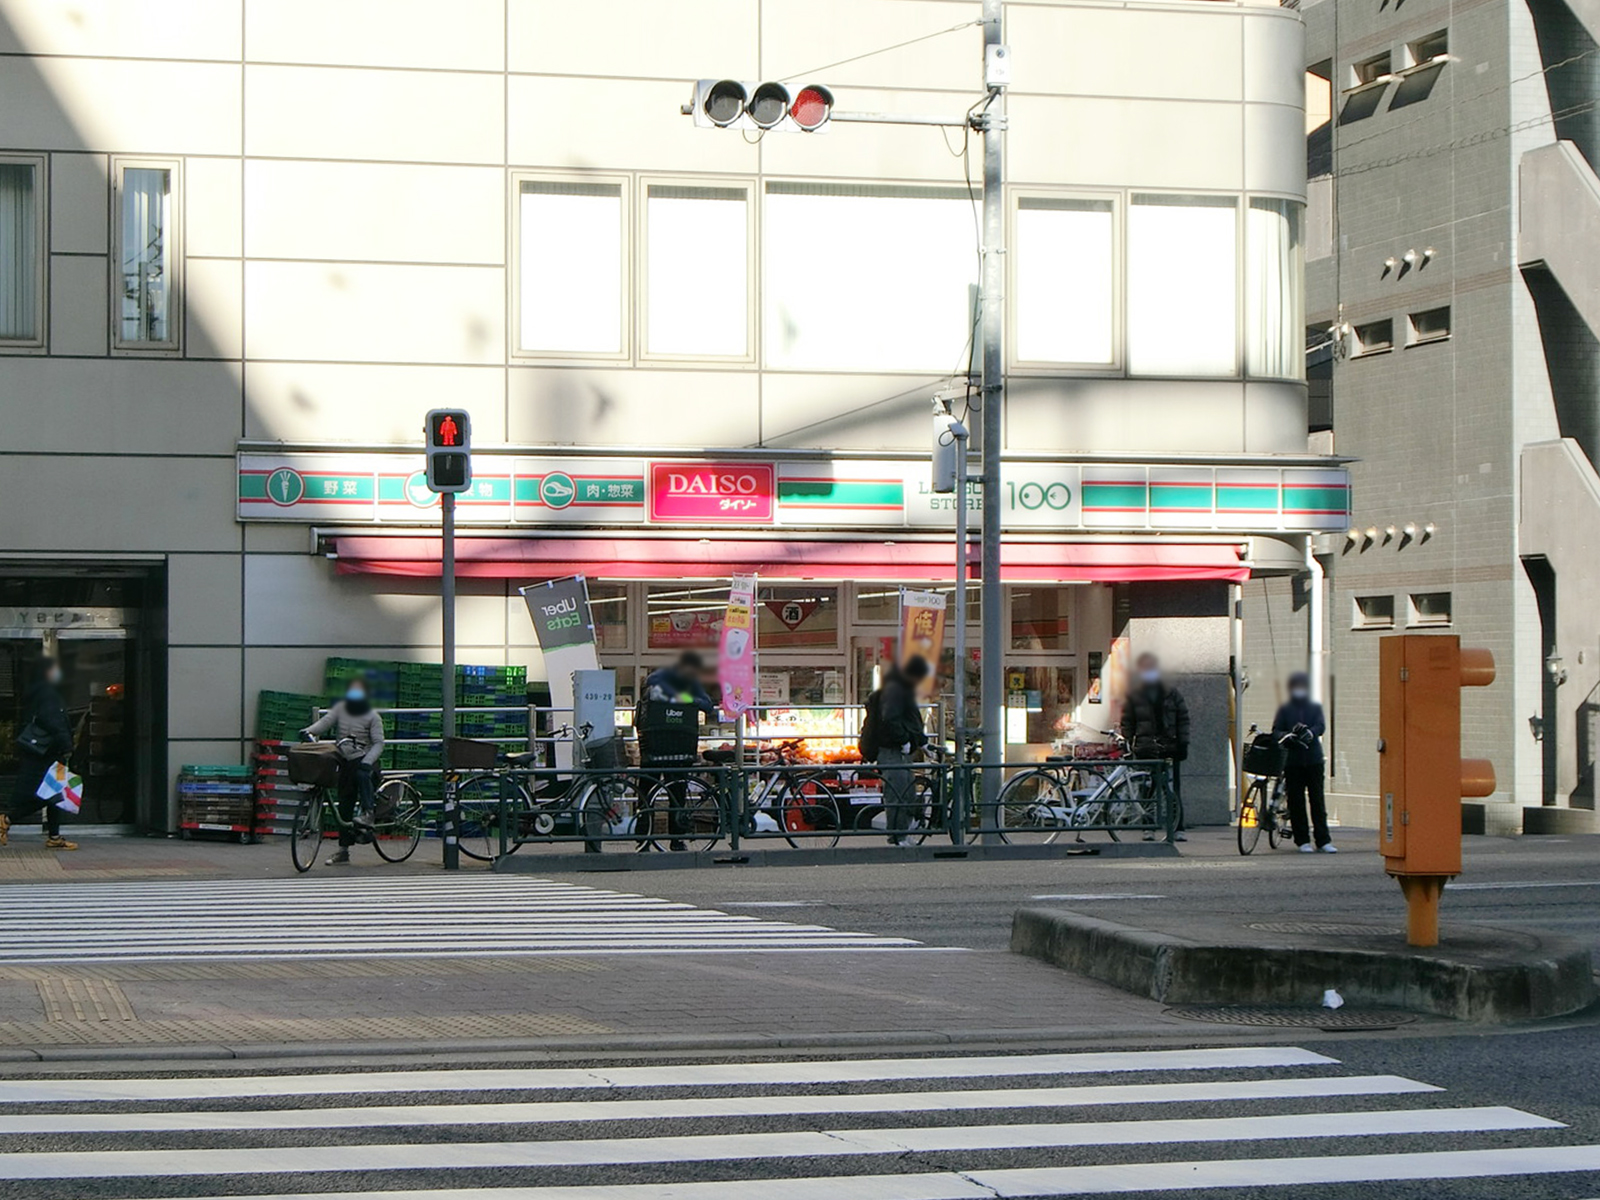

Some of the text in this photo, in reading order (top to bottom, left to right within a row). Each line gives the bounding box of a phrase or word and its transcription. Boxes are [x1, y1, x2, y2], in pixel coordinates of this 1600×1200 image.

[323, 480, 358, 495] 野菜
[668, 474, 757, 494] DAISO
[719, 498, 757, 510] ダイソー
[1006, 482, 1071, 511] 100
[785, 606, 800, 621] 酒
[665, 709, 684, 717] Uber
